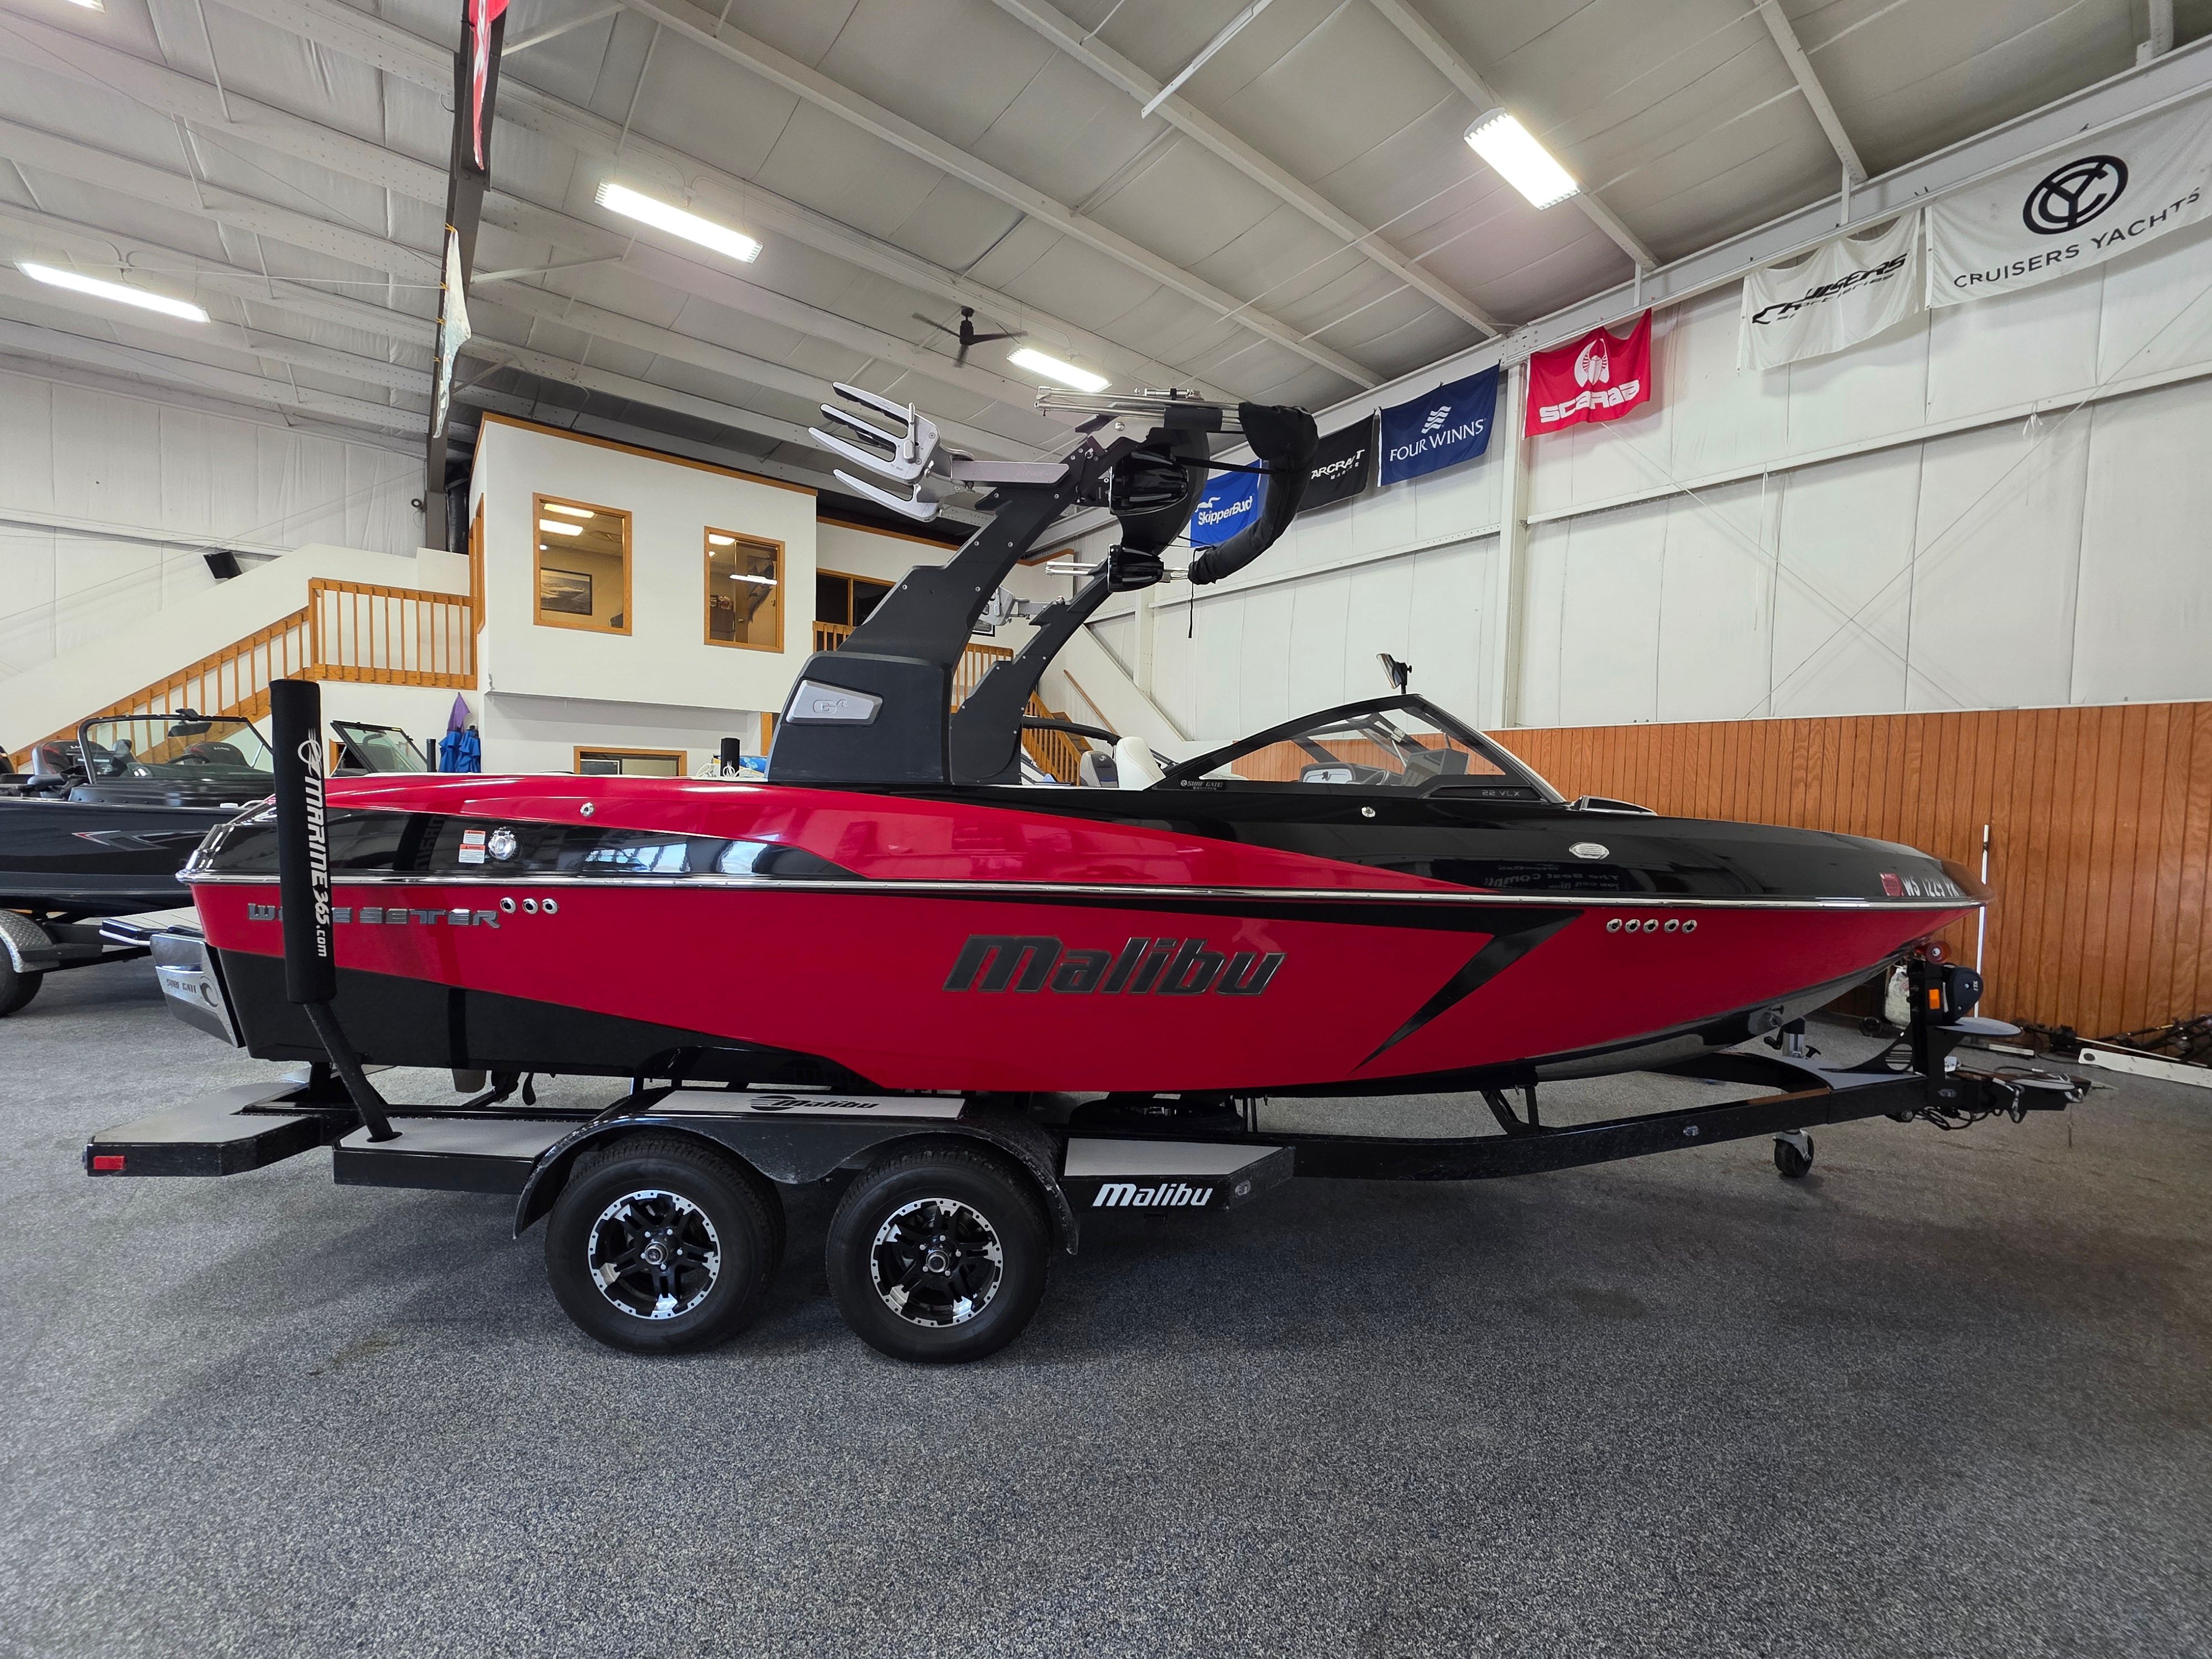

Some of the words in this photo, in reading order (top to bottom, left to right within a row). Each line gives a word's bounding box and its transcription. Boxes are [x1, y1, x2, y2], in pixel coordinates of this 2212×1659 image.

[1953, 244, 2080, 288] CRUISERS
[2090, 186, 2200, 249] YACHTS
[1389, 439, 1428, 462] FOUR
[1428, 419, 1484, 448] WINNS
[248, 902, 352, 924] WE
[359, 906, 500, 929] SETTER
[942, 933, 1287, 996] Malibu
[770, 1099, 880, 1108] Malibu
[1092, 1182, 1214, 1207] Malibu
